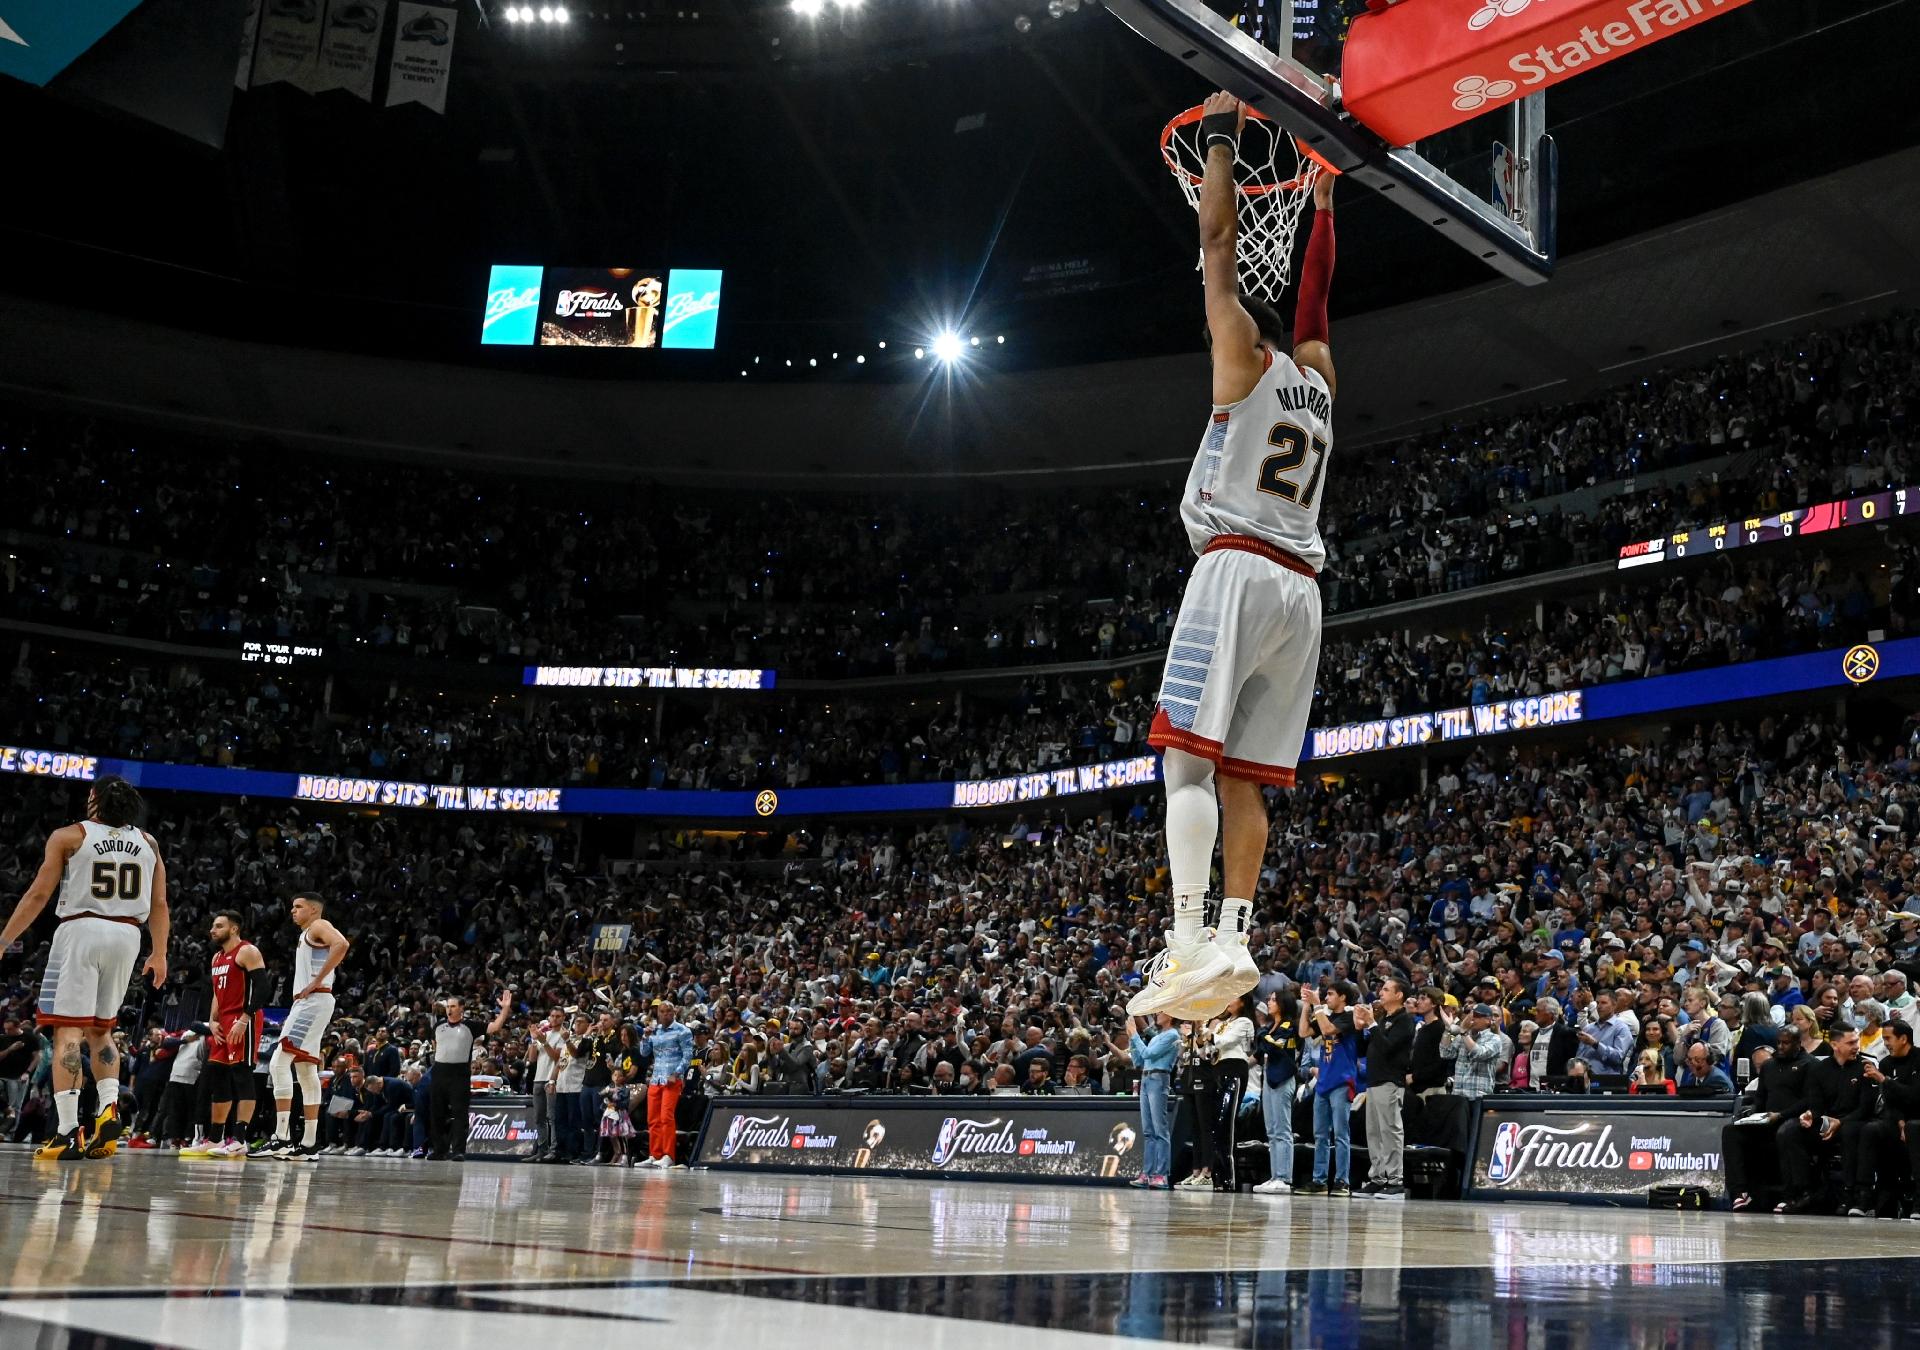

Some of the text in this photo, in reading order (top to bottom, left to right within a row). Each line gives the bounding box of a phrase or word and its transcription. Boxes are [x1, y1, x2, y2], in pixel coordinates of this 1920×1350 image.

[1508, 20, 1637, 86] State
[563, 291, 624, 316] Finals
[1276, 385, 1330, 429] MURRA
[1257, 422, 1327, 509] 27
[1861, 501, 1876, 519] 0
[1897, 501, 1906, 515] 7
[1620, 538, 1665, 558] POINTSBET
[241, 652, 293, 664] LET'S GO!
[243, 642, 262, 651] FOR
[266, 644, 290, 654] YOUR
[535, 666, 603, 687] NOBODY
[604, 667, 642, 687] SITS
[676, 668, 704, 689] WE
[705, 669, 761, 689] SCORE
[1313, 691, 1581, 757] NOBODY SITS 'TIL WE SCORE
[20, 750, 97, 780] SCORE
[297, 775, 561, 811] NOBODY SITS 'TIL WE SCORE
[954, 757, 1156, 806] NOBODY SITS 'TIL WE SCORE
[93, 839, 142, 857] GORDON
[91, 861, 142, 901] 50
[217, 975, 228, 990] 31
[466, 1113, 509, 1143] Finals
[727, 1115, 790, 1159] Finals
[938, 1117, 1017, 1167] Finals
[1498, 1123, 1623, 1185] Finals
[1630, 1136, 1672, 1152] Presented by
